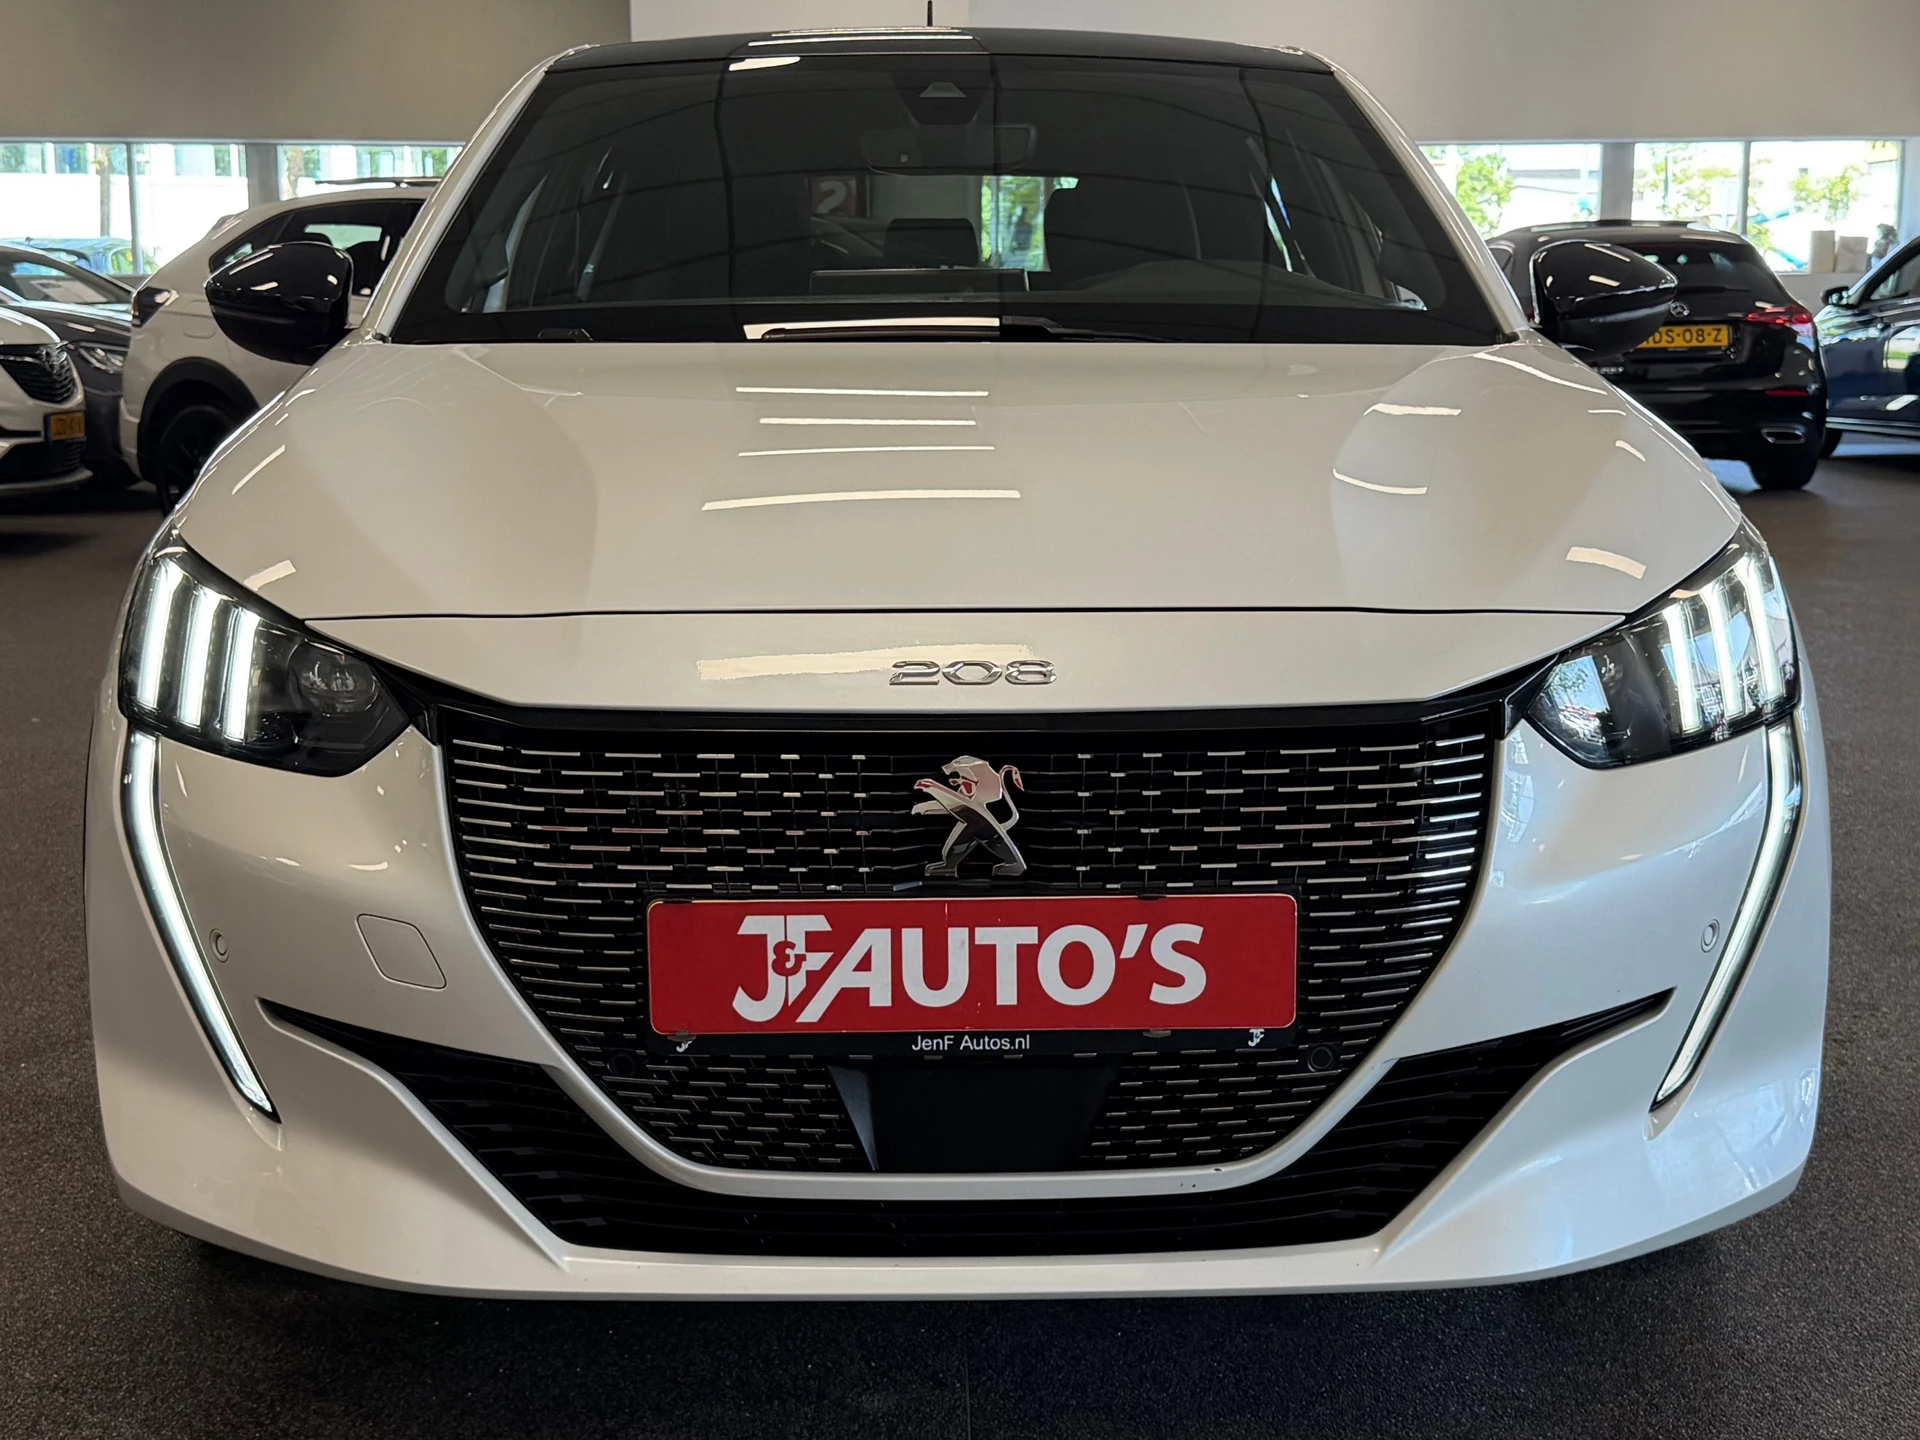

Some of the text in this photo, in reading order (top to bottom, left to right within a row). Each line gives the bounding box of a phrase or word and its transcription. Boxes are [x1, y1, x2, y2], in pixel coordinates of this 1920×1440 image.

[1647, 328, 1722, 344] DS-08-Z
[889, 659, 1057, 686] 208
[795, 923, 1207, 1022] AUTO'S
[911, 1034, 1031, 1051] JenF Autos.nl
